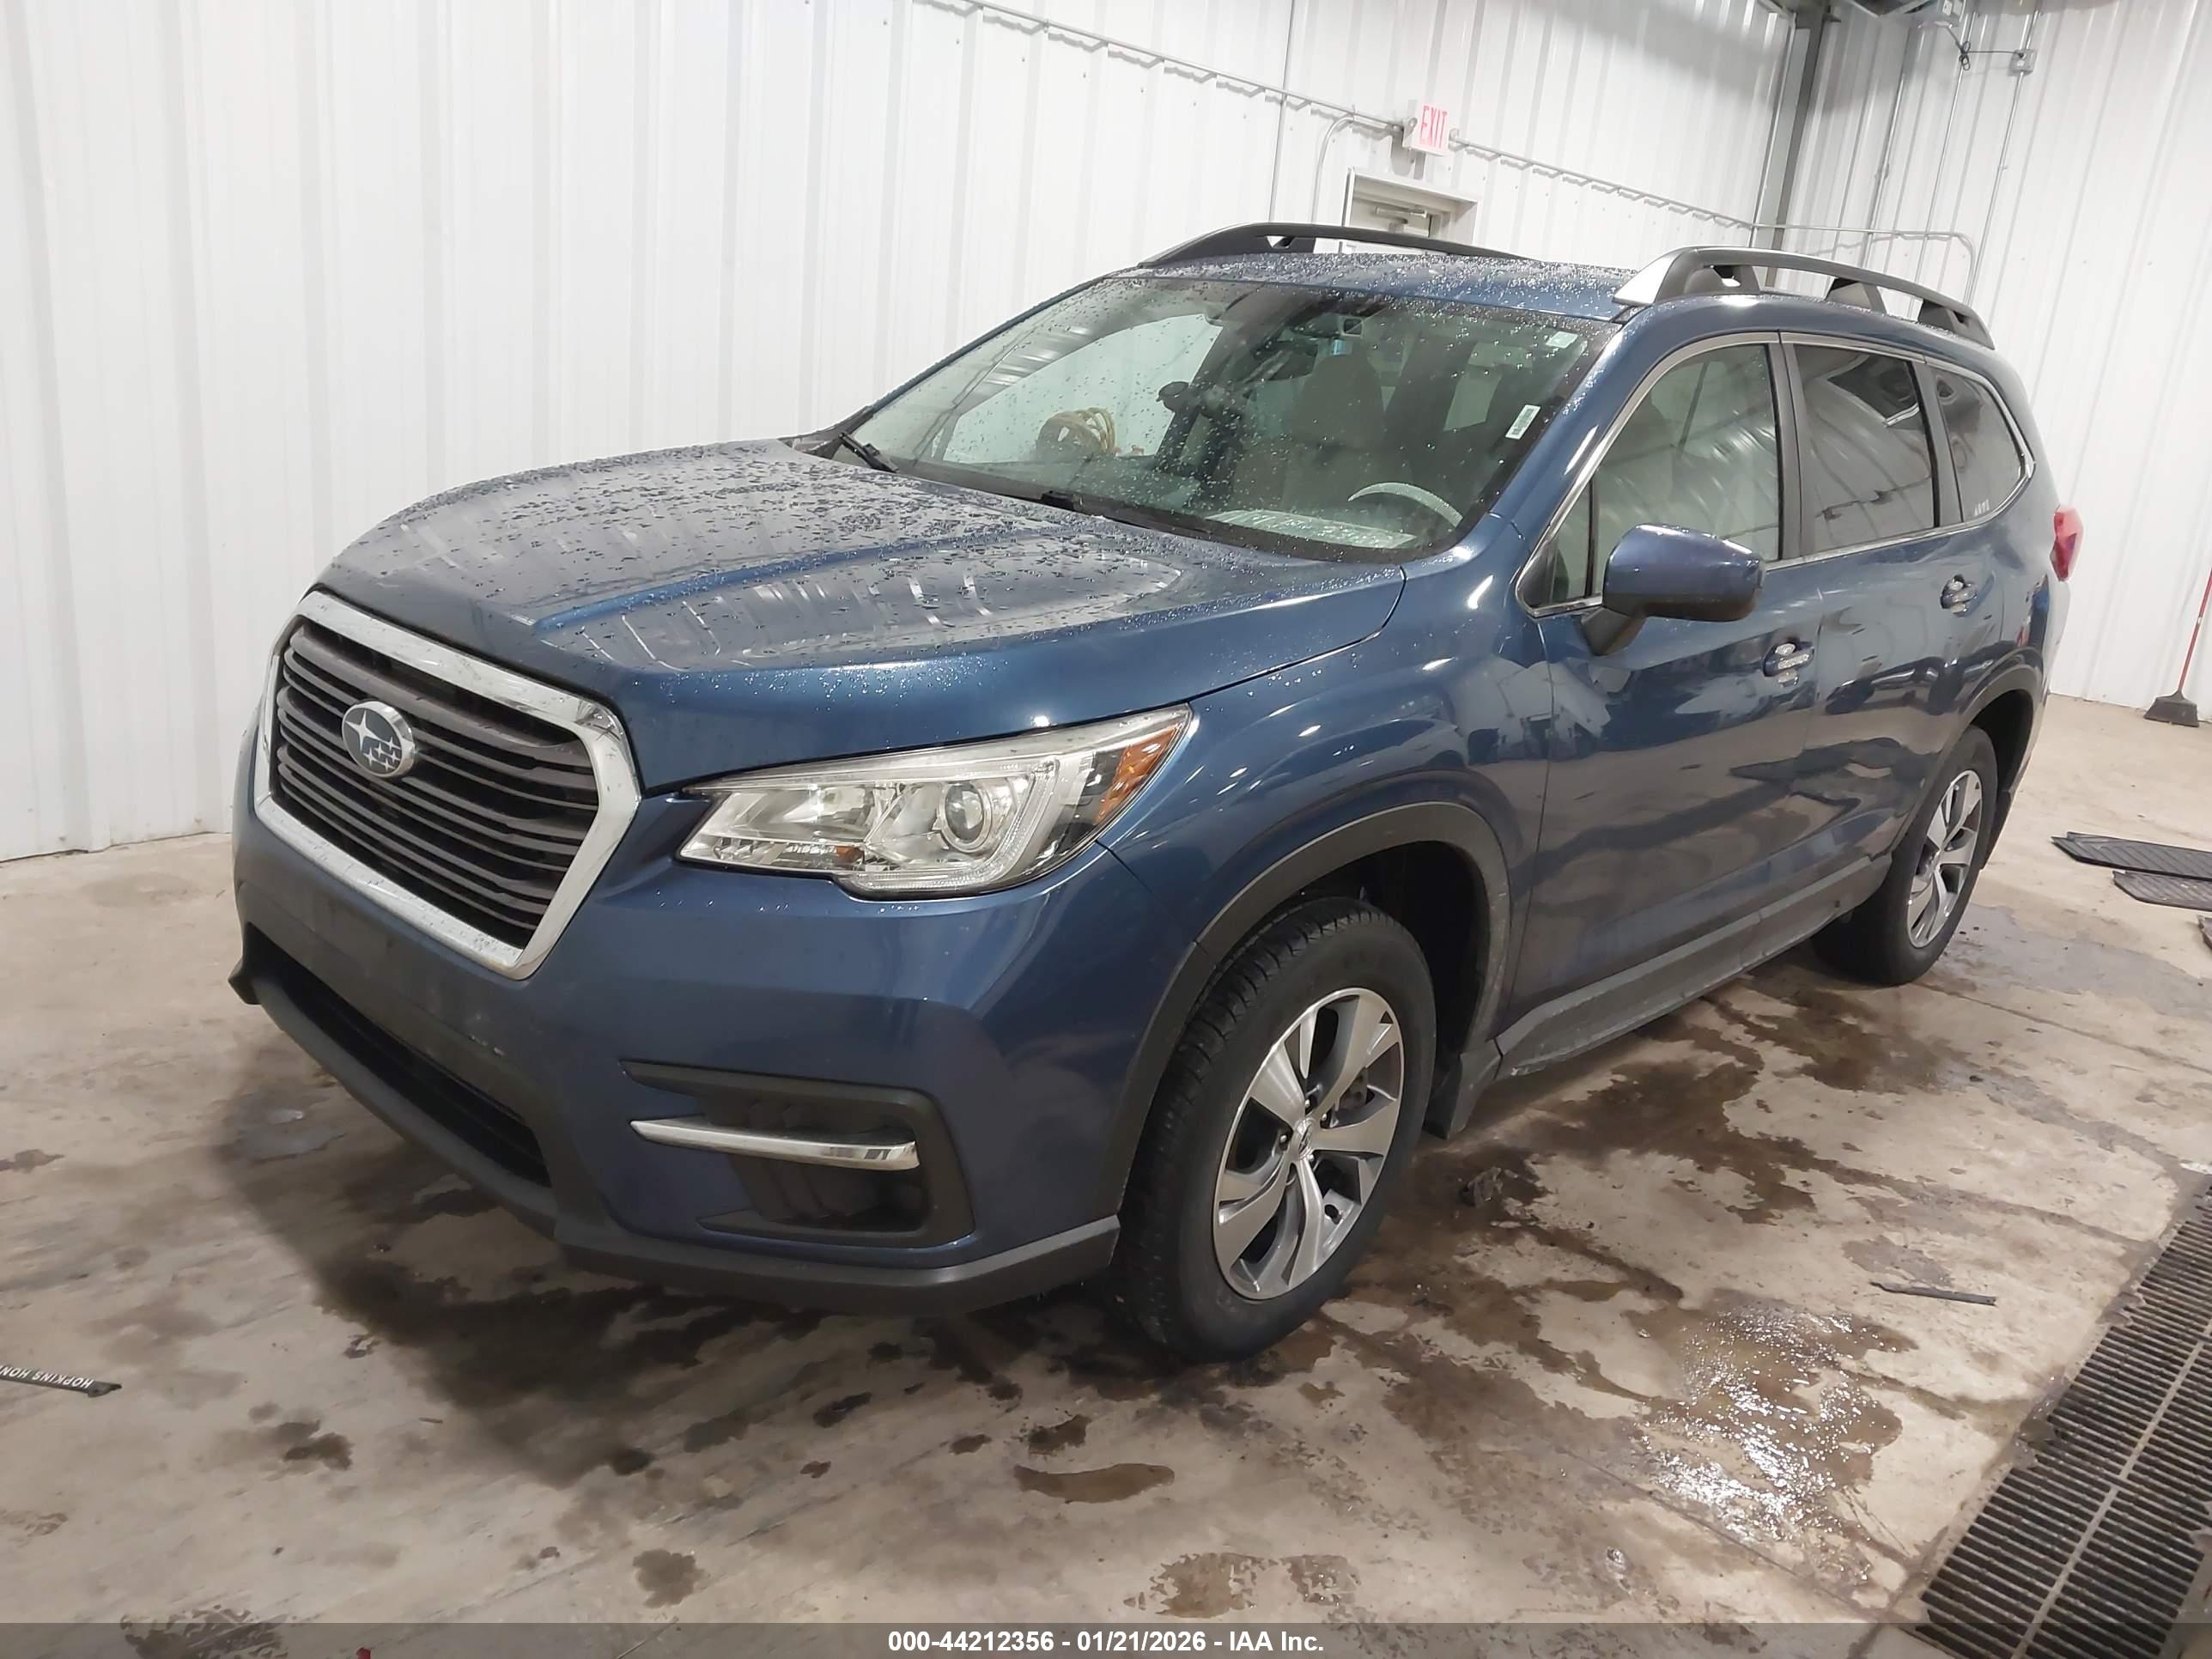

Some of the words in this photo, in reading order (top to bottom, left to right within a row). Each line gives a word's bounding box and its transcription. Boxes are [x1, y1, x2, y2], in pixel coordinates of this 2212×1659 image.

[1419, 105, 1448, 149] EXIT
[0, 1365, 32, 1379] HON
[32, 1370, 94, 1389] HOPKINS
